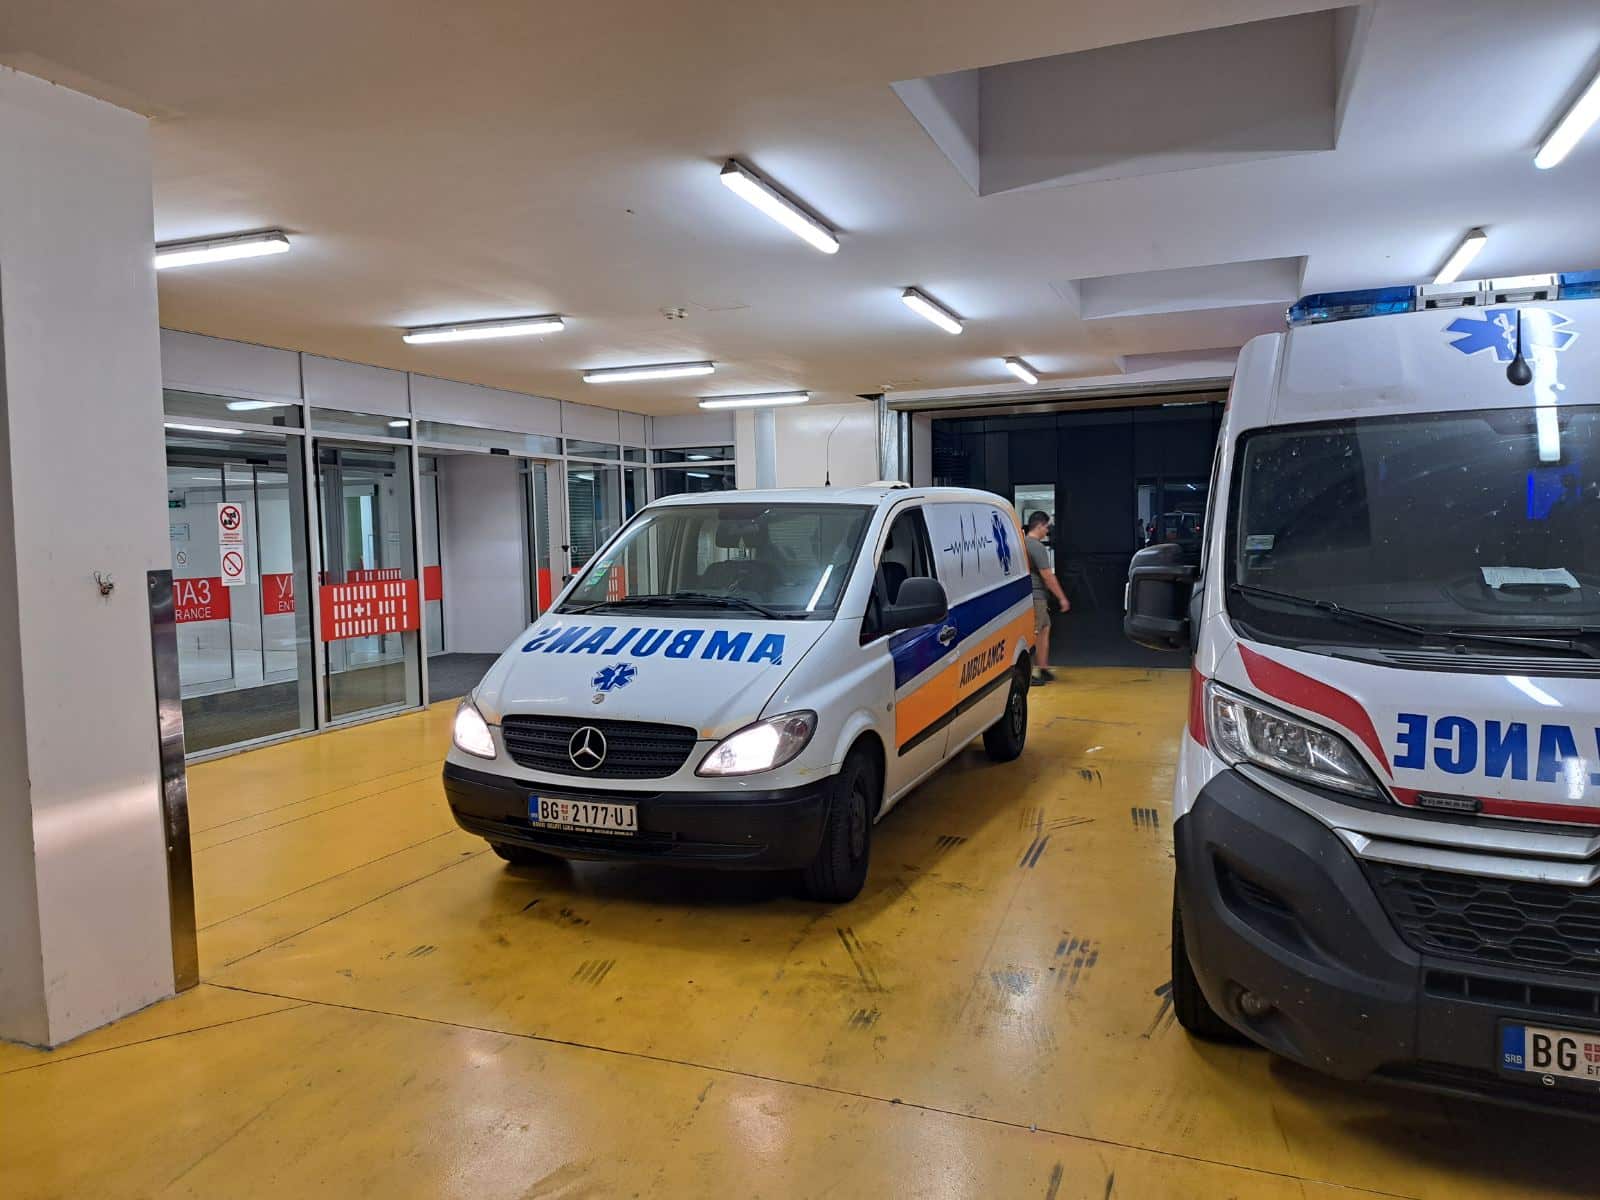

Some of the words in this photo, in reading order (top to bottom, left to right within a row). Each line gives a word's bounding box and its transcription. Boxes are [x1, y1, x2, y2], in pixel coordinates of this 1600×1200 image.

[959, 638, 1006, 688] AMBULANCE
[541, 800, 559, 820] BG
[1504, 1052, 1523, 1065] SRB
[1532, 1033, 1577, 1072] BG
